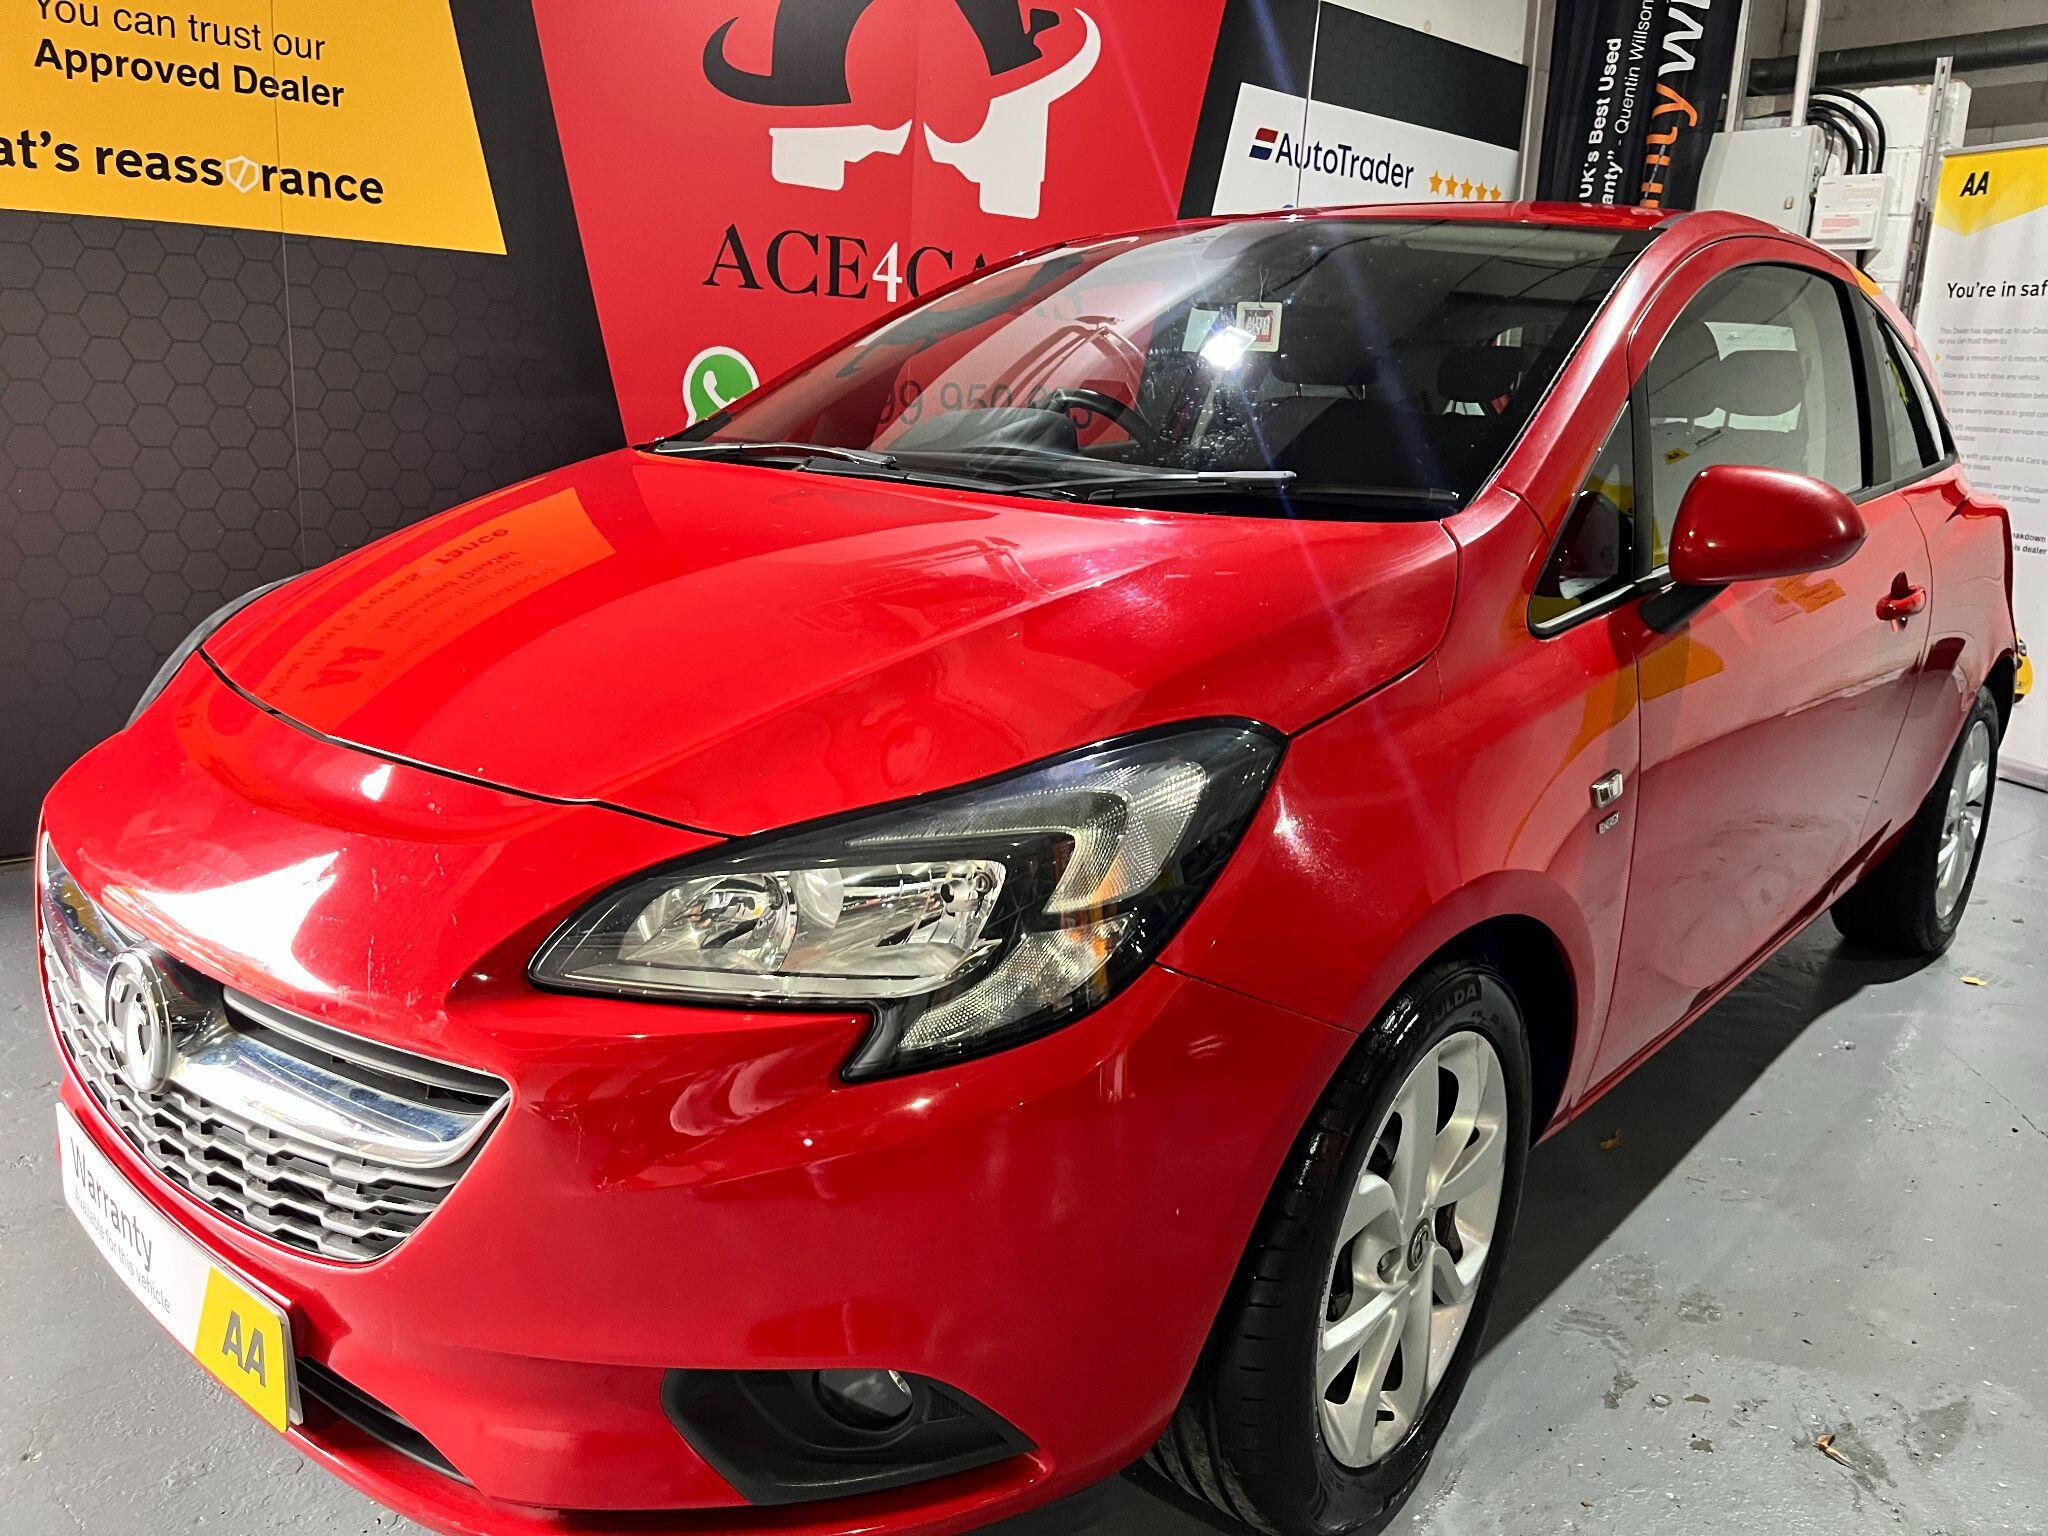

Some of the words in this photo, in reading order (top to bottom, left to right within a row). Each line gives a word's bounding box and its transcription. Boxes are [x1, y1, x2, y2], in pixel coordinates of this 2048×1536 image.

[37, 0, 100, 28] You
[113, 8, 176, 38] can
[188, 14, 262, 52] trust
[273, 33, 326, 61] our
[34, 38, 220, 91] Approved
[234, 64, 345, 108] Dealer
[1598, 38, 1623, 92] Used
[1589, 96, 1612, 145] Best
[1614, 66, 1642, 135] Quentin
[1275, 133, 1415, 188] AutoTrader
[1579, 150, 1600, 199] UK's
[1959, 171, 1990, 197] AA
[1947, 282, 1996, 298] You're
[2001, 281, 2016, 297] in
[70, 1137, 153, 1272] Warranty
[117, 1242, 135, 1278] this
[135, 1269, 172, 1314] vehicle
[222, 1310, 266, 1388] AA
